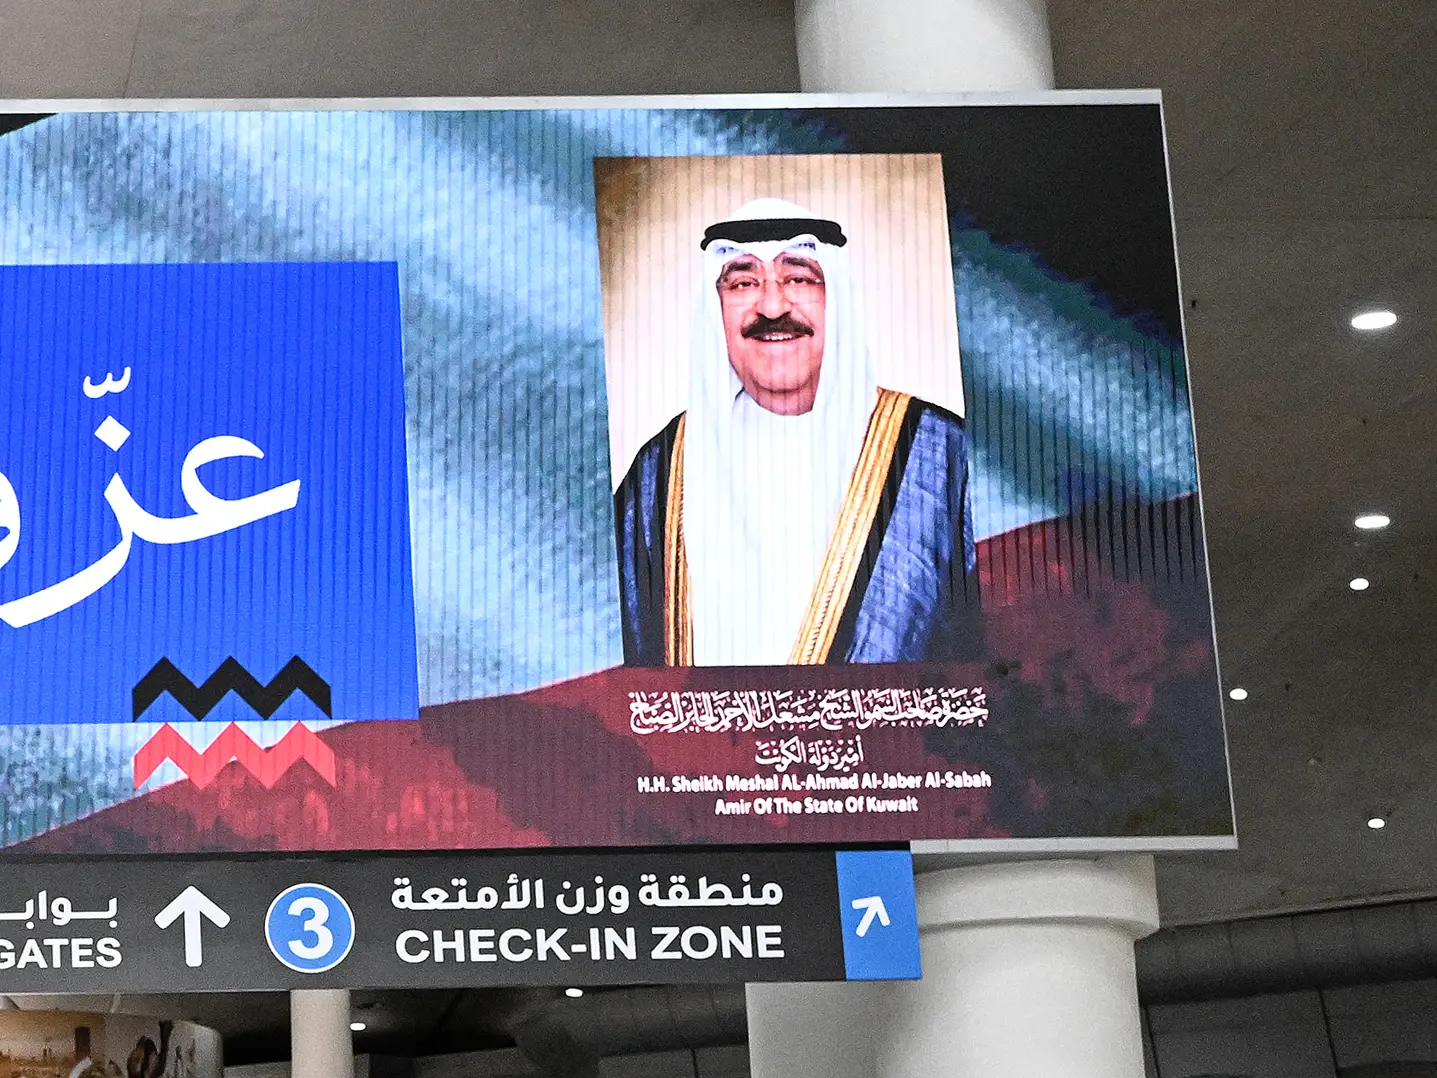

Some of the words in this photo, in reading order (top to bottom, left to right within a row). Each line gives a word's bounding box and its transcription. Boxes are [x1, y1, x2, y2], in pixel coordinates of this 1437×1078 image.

[637, 776, 670, 793] H.H.
[672, 775, 723, 792] Sheikh
[726, 774, 778, 791] Meshal
[862, 772, 922, 790] Al-Jaber
[925, 771, 992, 789] Al-Sabah
[715, 799, 752, 815] Amir
[753, 798, 772, 815] Of
[774, 798, 802, 814] The
[805, 796, 843, 814] State
[845, 796, 864, 813] Of
[866, 795, 919, 813] Kuwait
[390, 875, 546, 912] الأمتعة
[555, 881, 630, 916] وزن
[643, 873, 784, 908] منطقة
[287, 896, 335, 960] 3
[395, 926, 638, 965] CHECK-IN
[650, 925, 786, 960] ZONE
